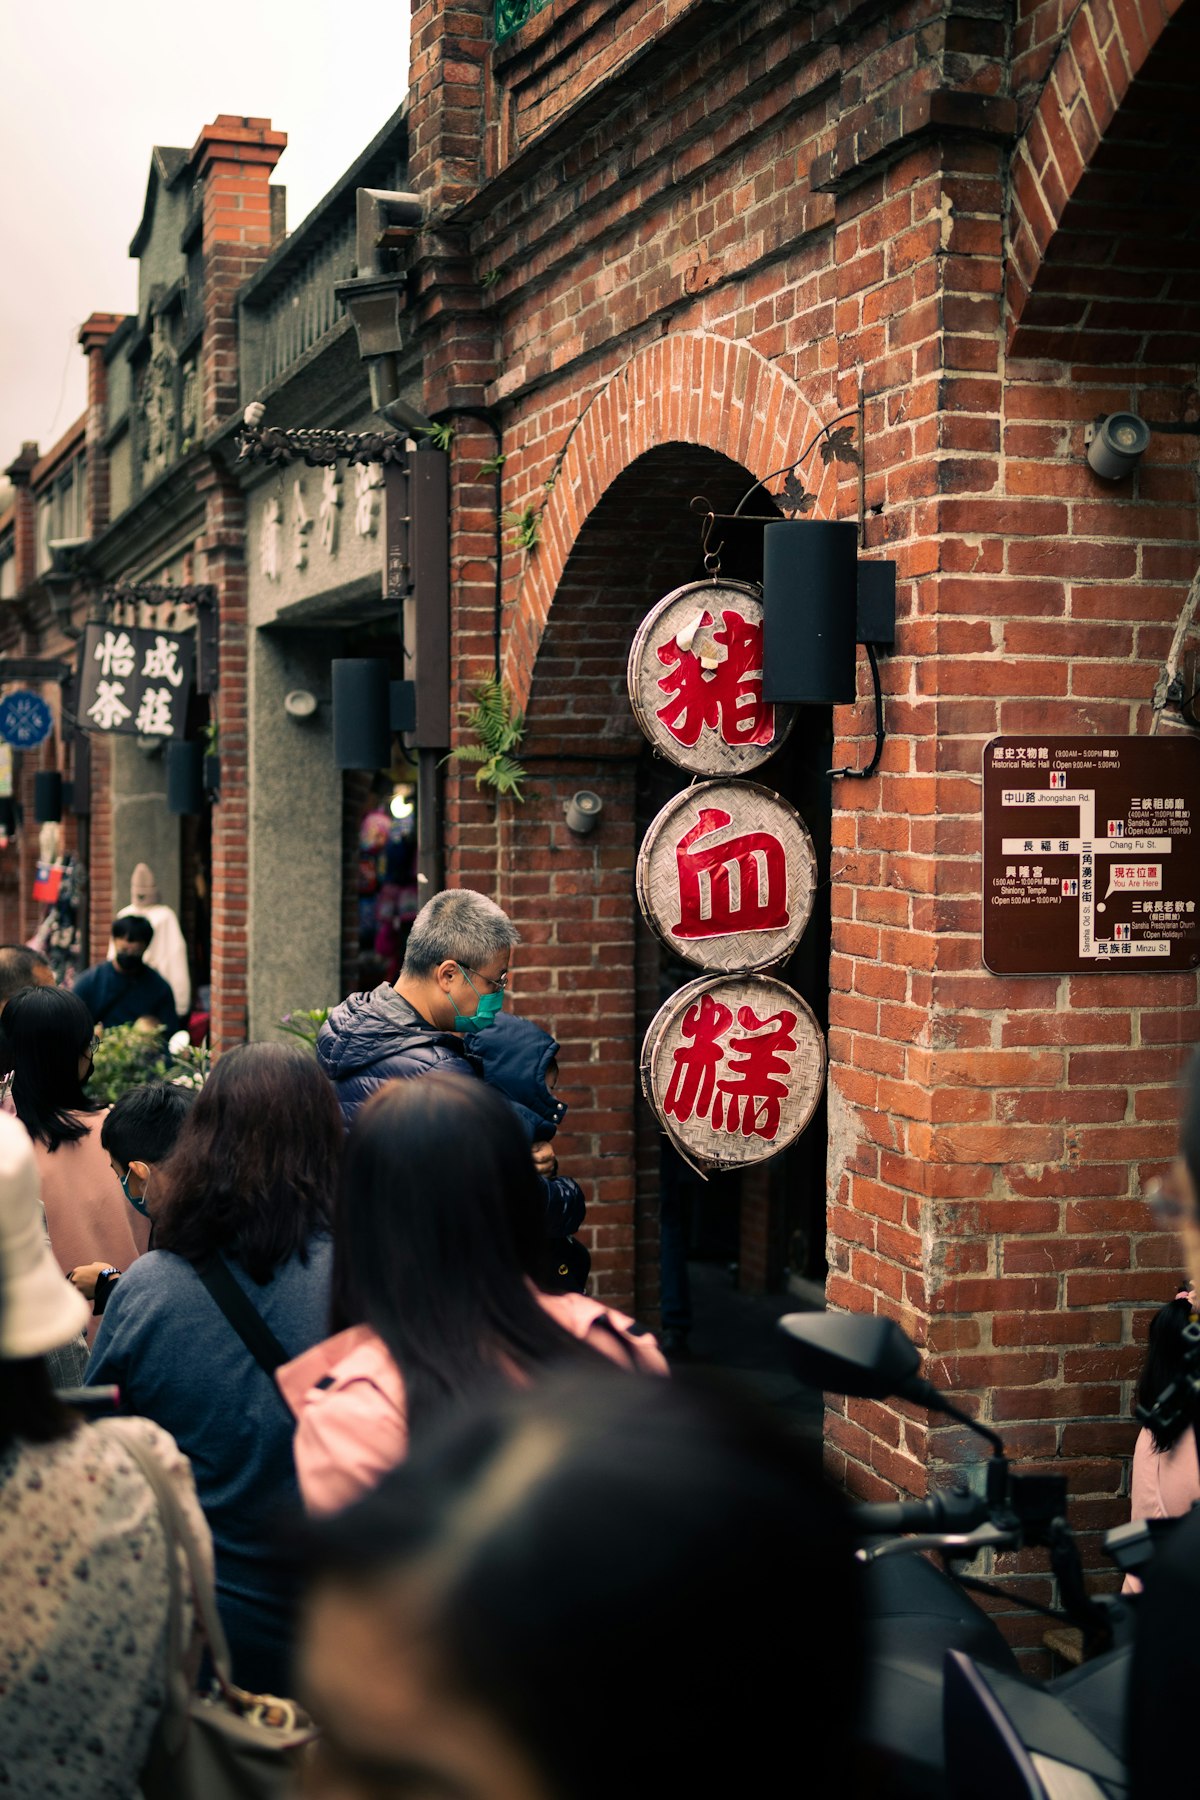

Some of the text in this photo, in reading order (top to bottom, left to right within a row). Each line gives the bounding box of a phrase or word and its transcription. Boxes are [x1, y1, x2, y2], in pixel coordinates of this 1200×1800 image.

[94, 631, 183, 687] 怡成
[87, 680, 174, 736] 茶莊
[993, 748, 1049, 759] 歷史文物館
[992, 761, 1019, 769] Historical
[1021, 761, 1036, 769] Relic
[1038, 761, 1050, 769] Hall
[1004, 792, 1036, 803] 中山路
[1037, 794, 1076, 803] Jhongshan
[1127, 819, 1189, 828] Sanshia Zushi Temple
[1024, 841, 1156, 852] 長福街 Chang Fu St.
[1082, 841, 1092, 903] 三角湧老街
[1115, 867, 1157, 878] 現在位置
[1027, 886, 1047, 895] Temple
[1132, 901, 1196, 913] 三峽長老教會
[1150, 921, 1179, 931] Presbyterian
[1179, 921, 1196, 929] Church
[1098, 943, 1132, 954] 民族街
[1158, 944, 1169, 952] St.
